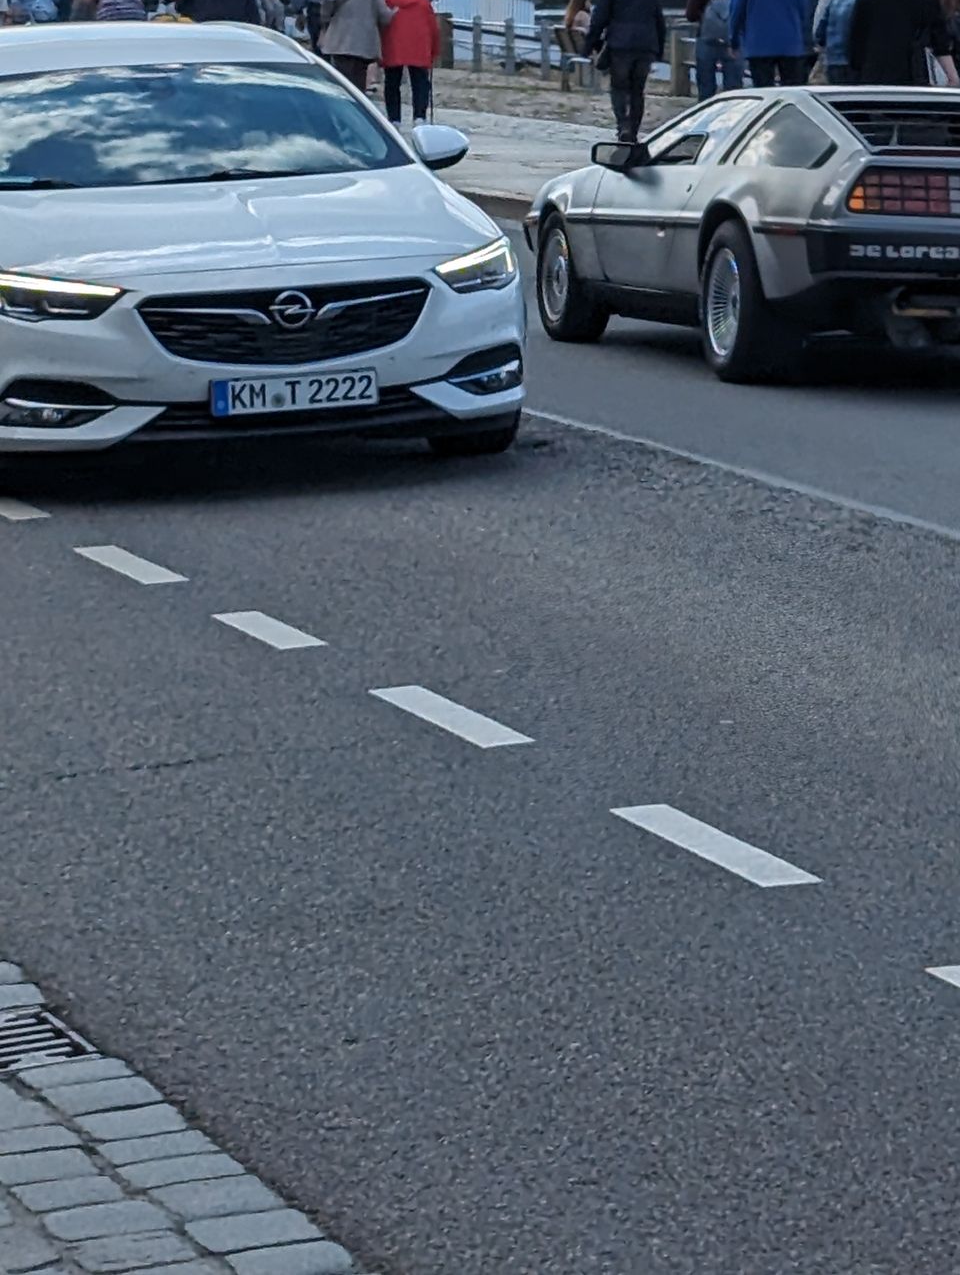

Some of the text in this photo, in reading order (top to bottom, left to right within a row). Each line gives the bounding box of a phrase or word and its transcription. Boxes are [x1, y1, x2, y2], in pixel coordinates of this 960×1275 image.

[230, 375, 374, 410] KM T 2222
